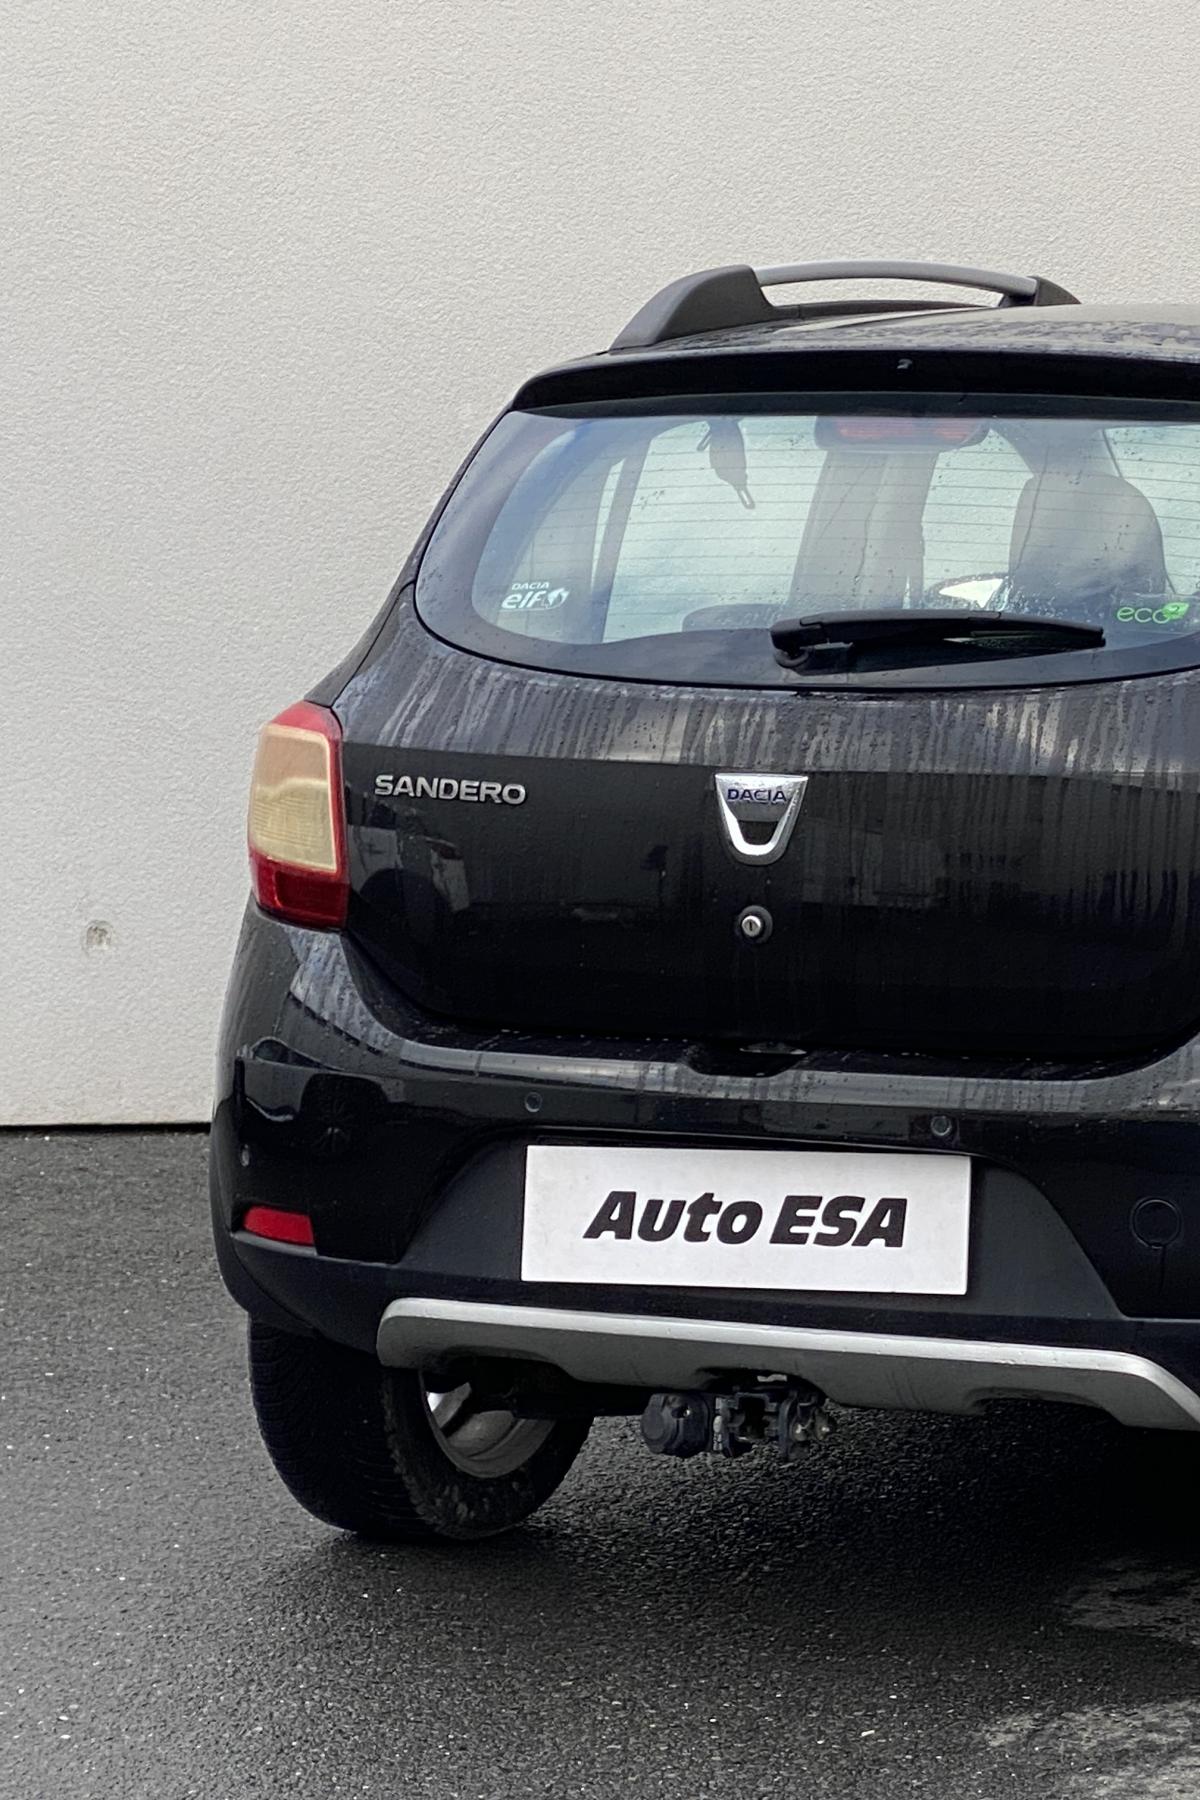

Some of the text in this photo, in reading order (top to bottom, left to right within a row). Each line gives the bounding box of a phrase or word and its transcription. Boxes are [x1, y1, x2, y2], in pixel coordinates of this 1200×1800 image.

[511, 581, 550, 590] DACIA
[501, 590, 547, 609] elf
[374, 774, 526, 805] SANDERO
[727, 788, 787, 802] DACIA
[582, 1190, 907, 1248] Auto ESA
